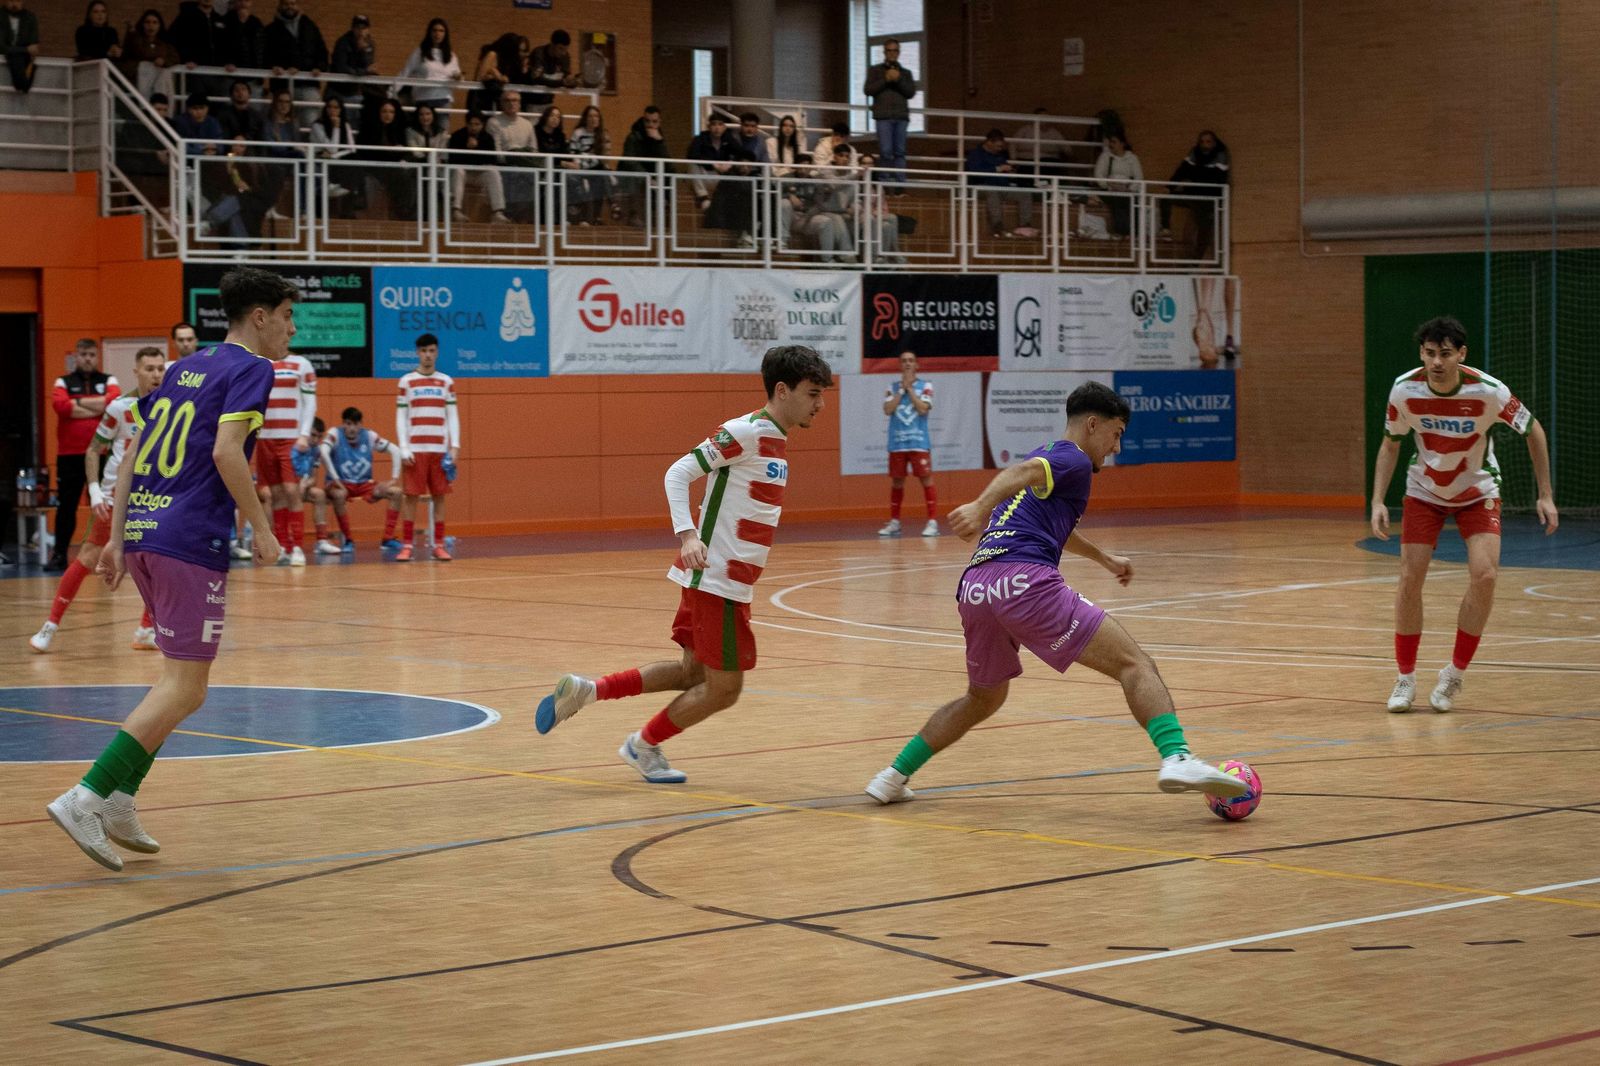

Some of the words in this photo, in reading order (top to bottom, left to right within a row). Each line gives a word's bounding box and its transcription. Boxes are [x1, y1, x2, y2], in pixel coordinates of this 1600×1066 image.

[322, 273, 362, 289] INGLÉS
[380, 286, 453, 309] QUIRO
[793, 288, 841, 303] SACOS
[578, 277, 685, 333] Galilea
[902, 301, 995, 317] RECURSOS
[399, 311, 488, 331] ESENCIA
[786, 308, 848, 326] DÚRCAL
[902, 319, 996, 331] PUBLICITARIOS
[177, 370, 207, 388] SAMU
[1121, 395, 1161, 412] ERO
[1163, 392, 1231, 412] SÁNCHEZ
[133, 397, 196, 479] 20
